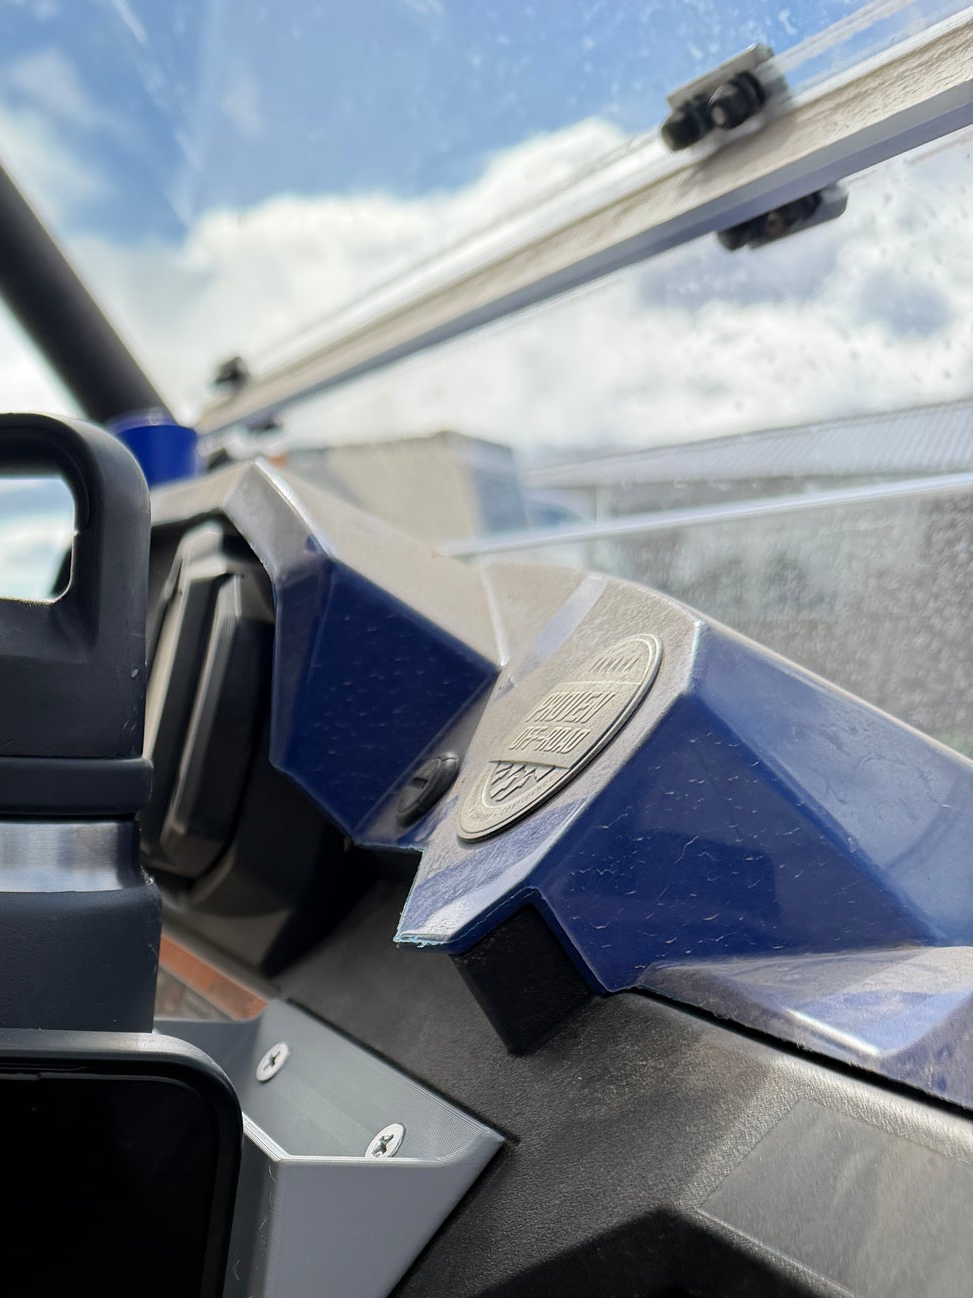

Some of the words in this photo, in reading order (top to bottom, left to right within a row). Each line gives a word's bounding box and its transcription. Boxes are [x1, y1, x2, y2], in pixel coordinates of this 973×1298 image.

[589, 655, 641, 674] YAMAHA
[525, 691, 617, 724] PROVEN
[508, 725, 592, 755] OFF-ROAD
